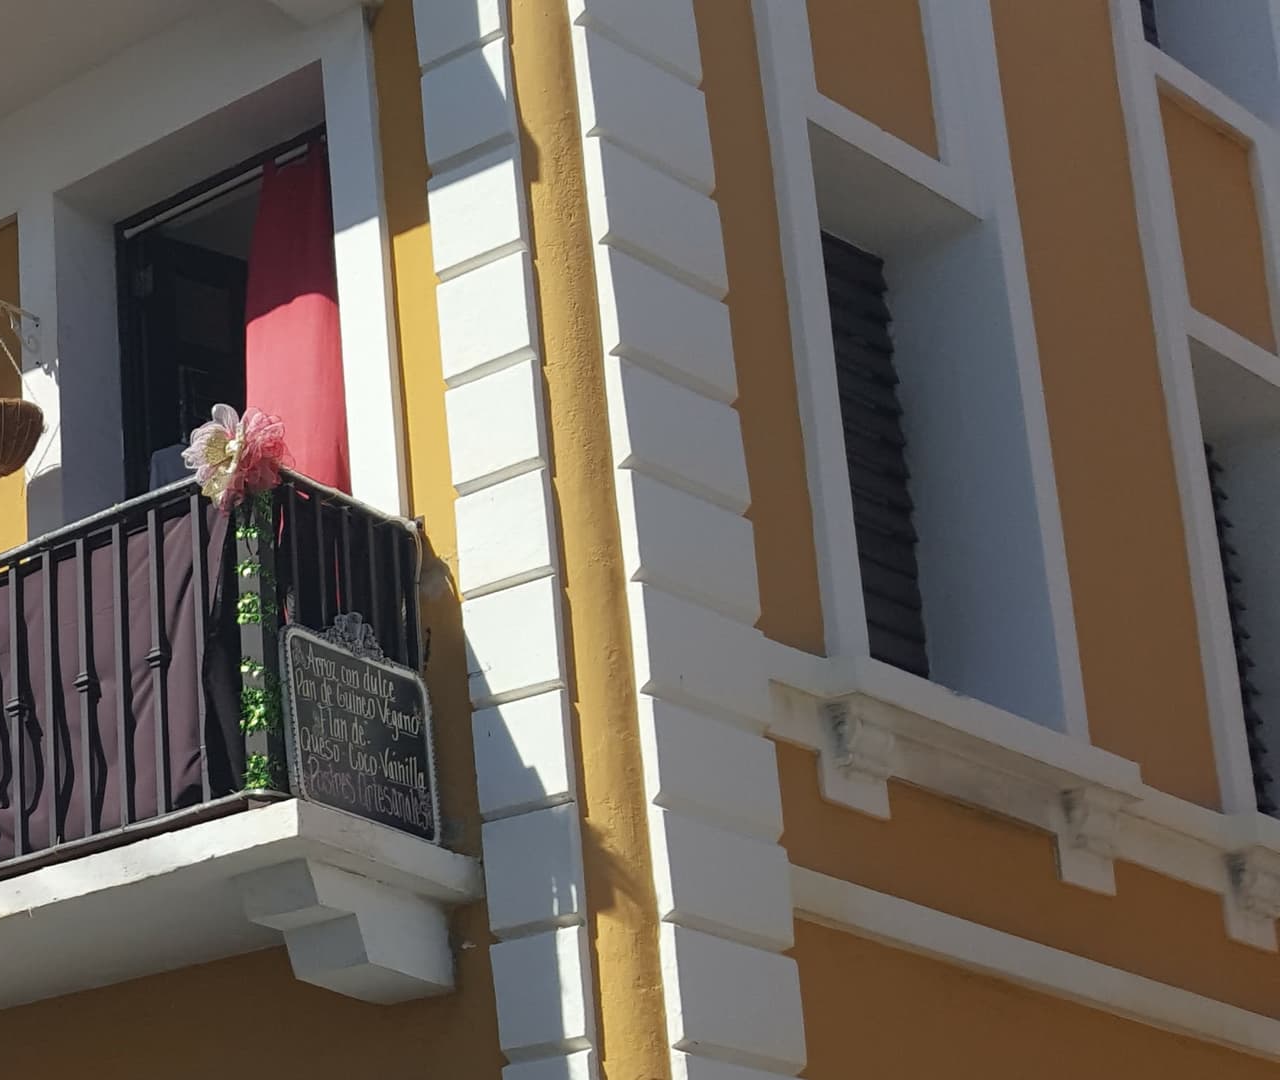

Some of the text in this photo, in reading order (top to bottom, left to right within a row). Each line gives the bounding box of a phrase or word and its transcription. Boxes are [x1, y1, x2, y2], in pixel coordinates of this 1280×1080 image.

[296, 670, 317, 700] Pan
[321, 678, 333, 704] de
[305, 643, 396, 700] Arroz con dulce
[300, 727, 340, 762] Queso
[349, 743, 377, 775] Coco
